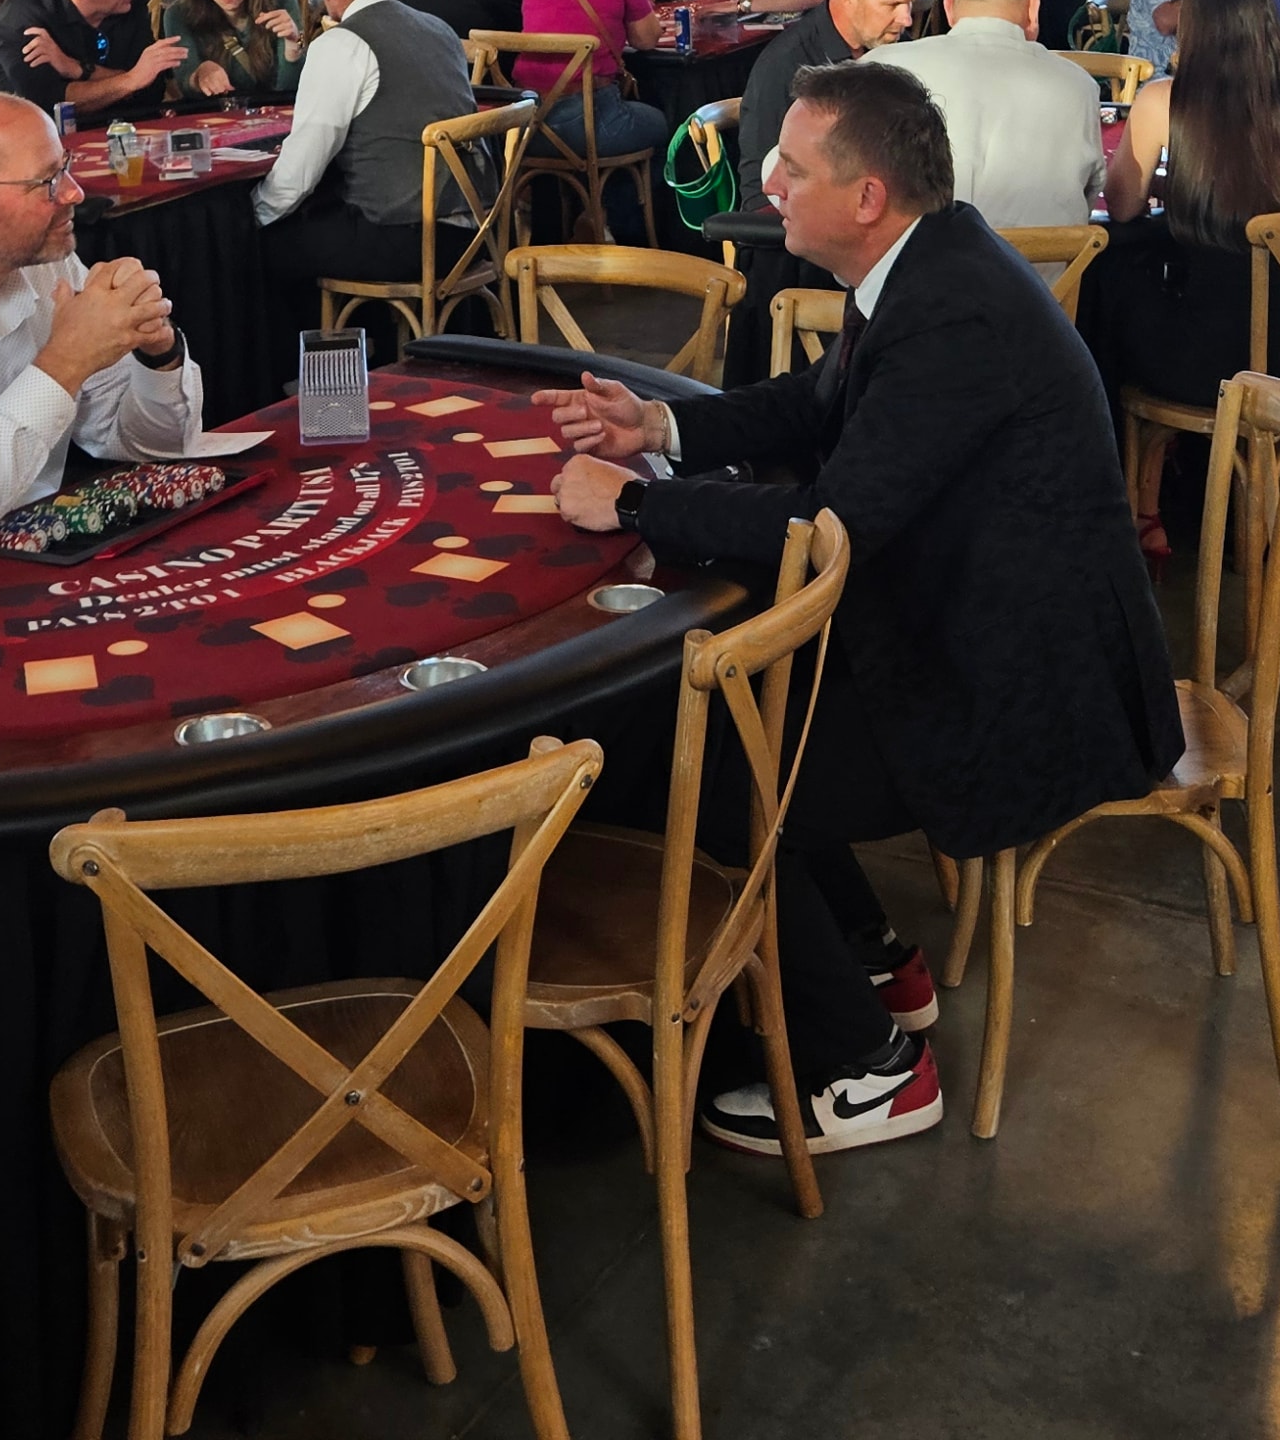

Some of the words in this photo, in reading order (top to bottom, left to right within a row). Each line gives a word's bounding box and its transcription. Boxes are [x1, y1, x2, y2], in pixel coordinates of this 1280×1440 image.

[355, 483, 381, 498] all
[353, 500, 376, 516] on
[48, 548, 236, 595] CASINO
[230, 498, 329, 550] PARTY
[298, 466, 335, 499] USA
[301, 516, 363, 551] stand
[28, 611, 126, 631] PAYS
[133, 605, 158, 617] 2
[161, 594, 217, 610] TO
[274, 516, 411, 583] BLACKJACK
[397, 480, 426, 507] PAYS
[220, 550, 303, 581] must
[79, 578, 212, 608] Dealer
